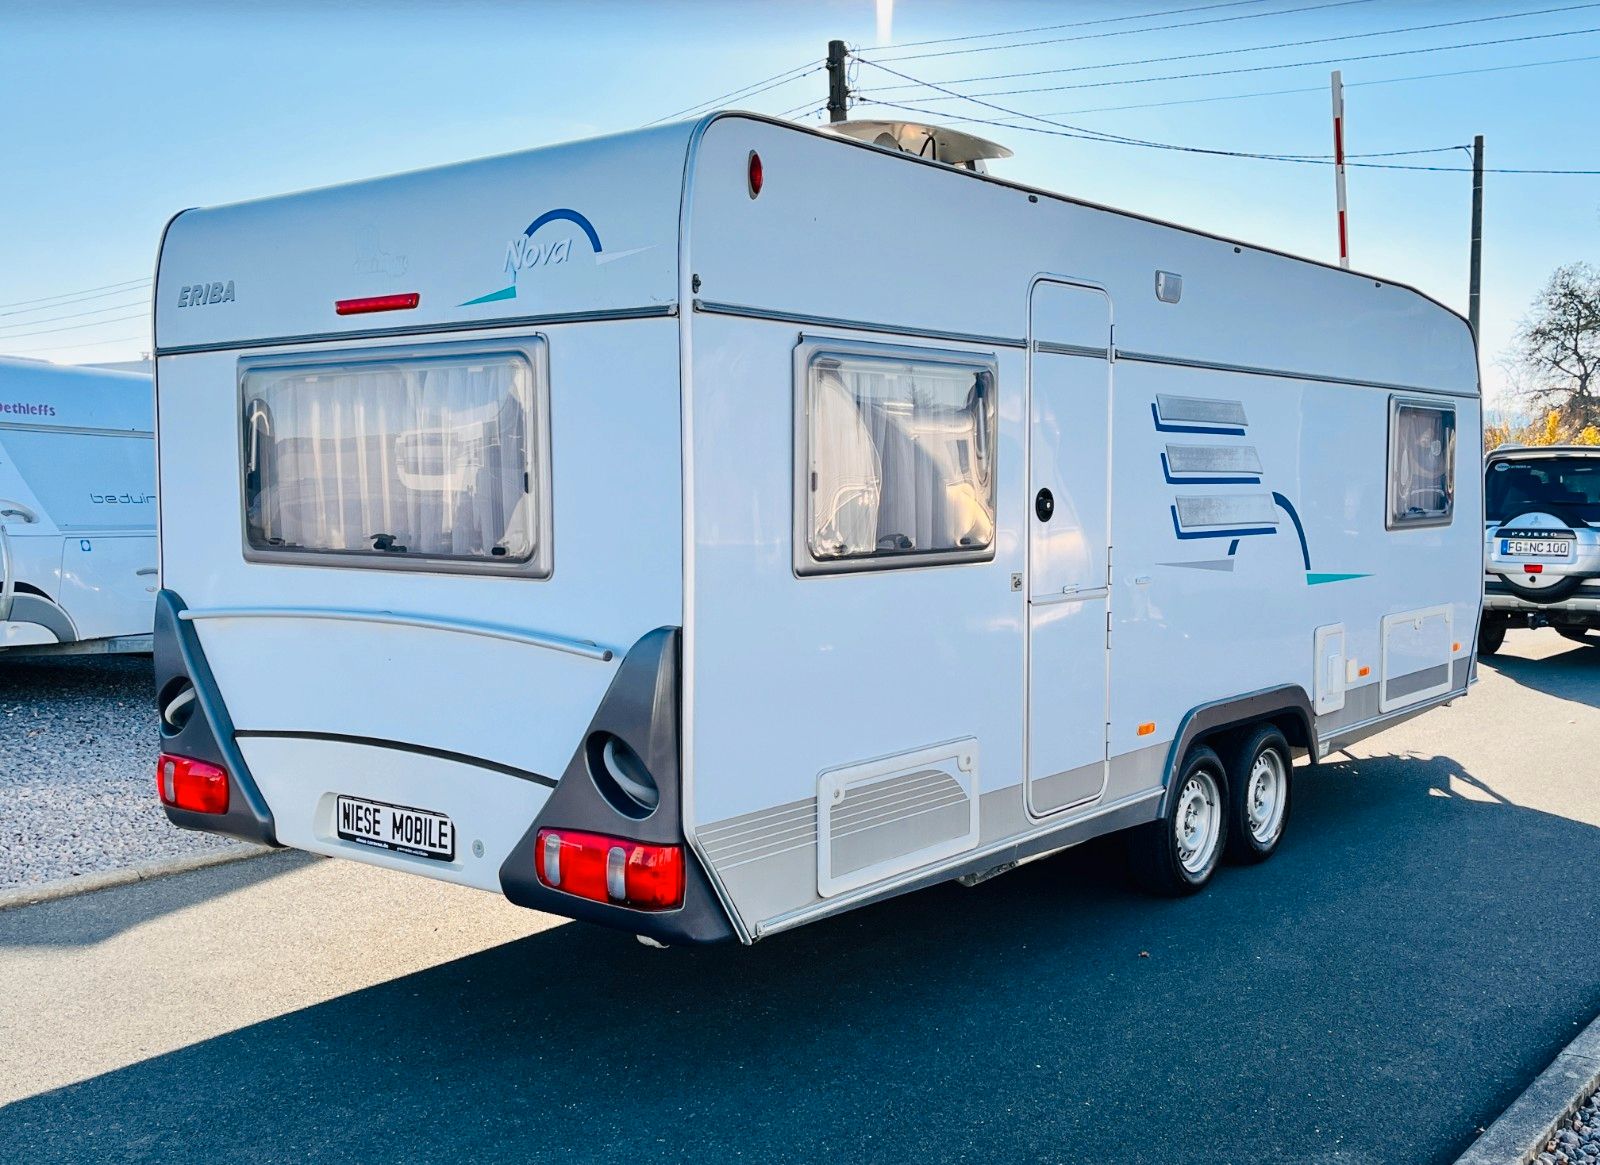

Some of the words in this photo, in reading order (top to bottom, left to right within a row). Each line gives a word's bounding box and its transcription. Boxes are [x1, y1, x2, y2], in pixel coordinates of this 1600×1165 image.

[503, 237, 573, 273] Nova
[178, 280, 236, 308] ERIBA
[1508, 541, 1522, 552] FG
[1529, 542, 1544, 553] NC
[1546, 543, 1567, 553] 100
[342, 802, 381, 837] NIESE
[391, 811, 448, 850] MOBILE
